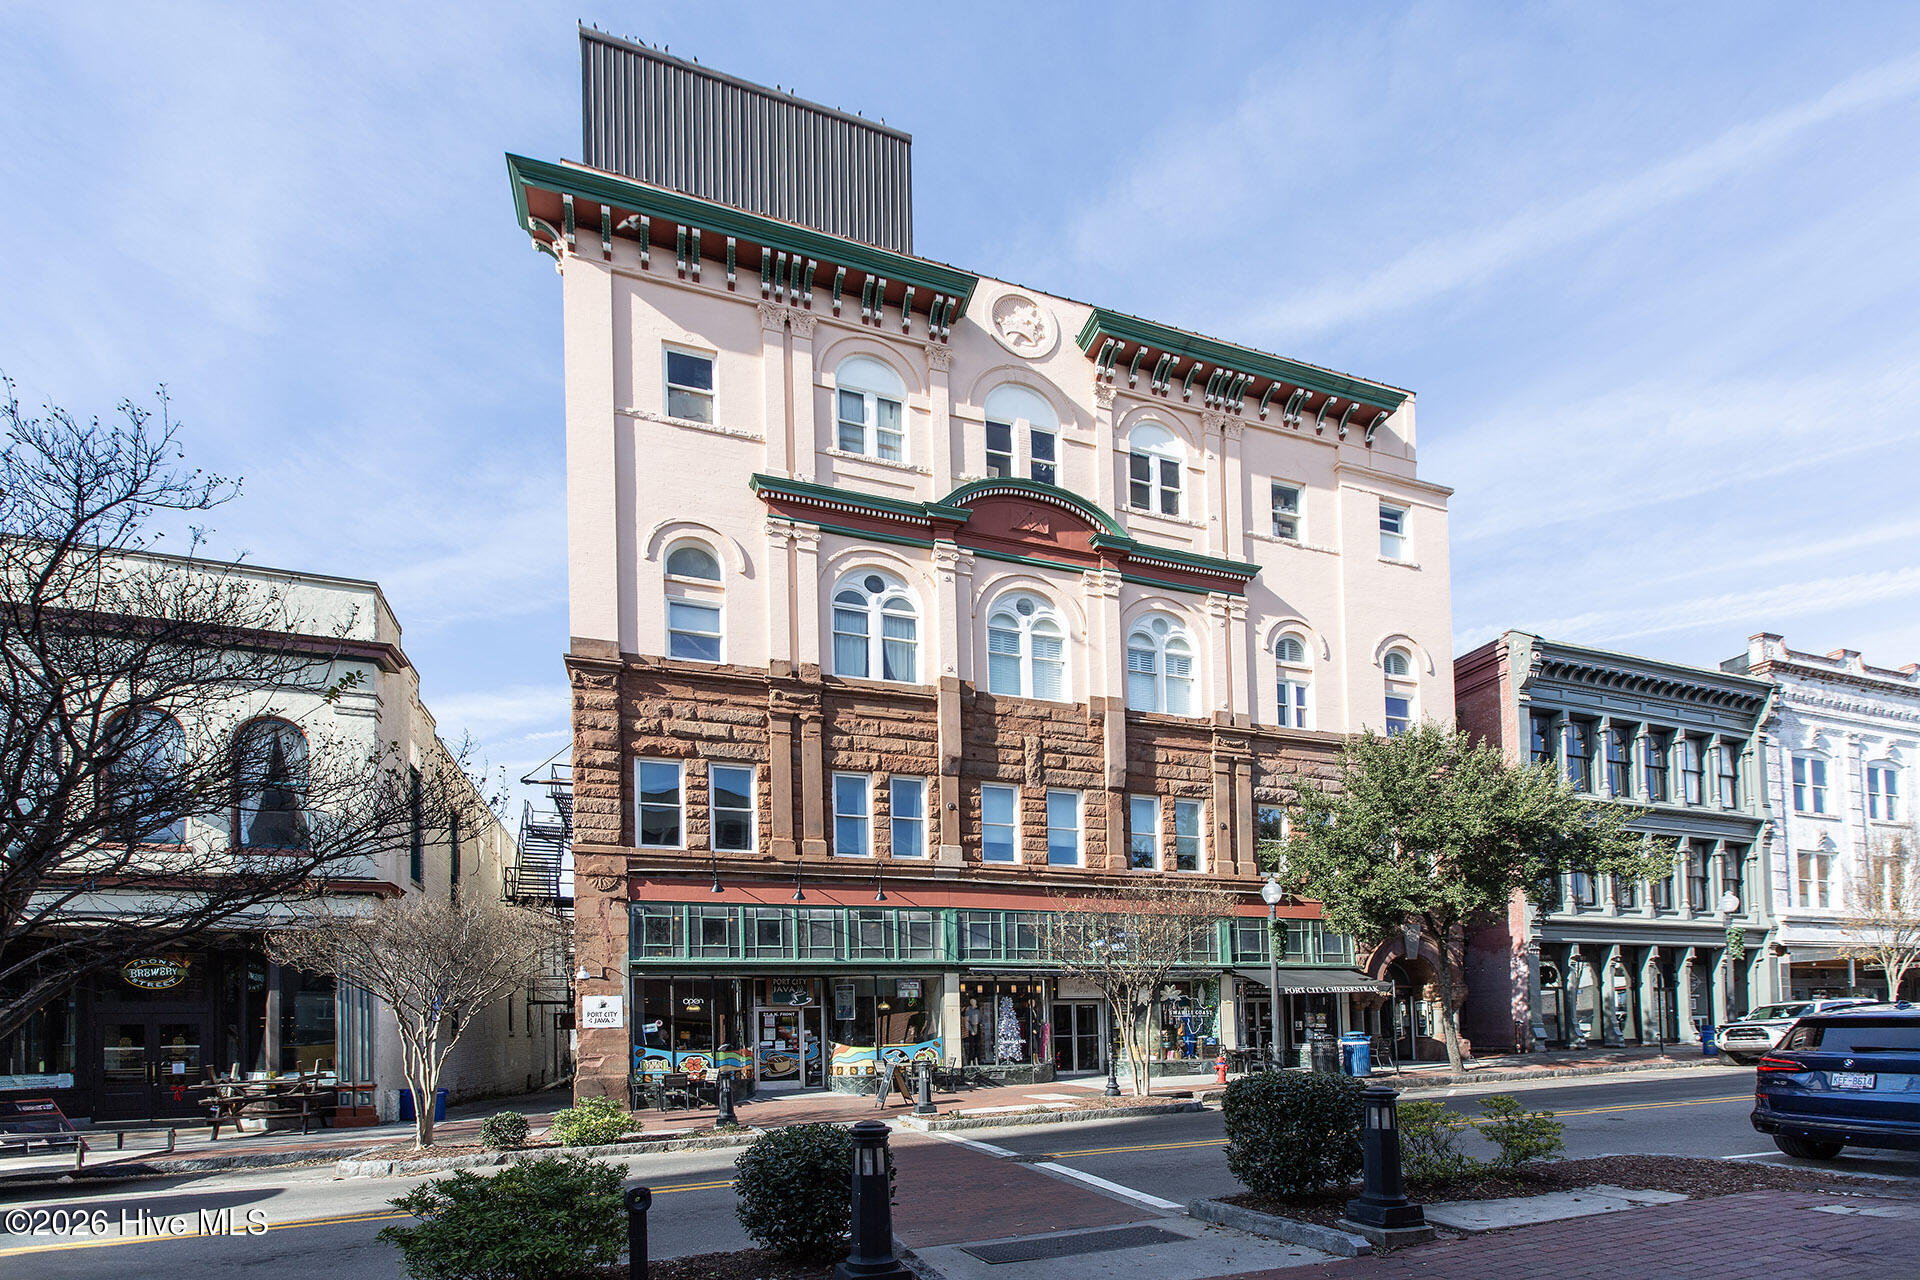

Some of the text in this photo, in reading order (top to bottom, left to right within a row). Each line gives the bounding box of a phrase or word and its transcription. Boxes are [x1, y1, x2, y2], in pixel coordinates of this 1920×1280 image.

[133, 958, 176, 967] FRONT
[128, 967, 178, 978] BREWERY
[131, 978, 176, 988] STREET
[773, 985, 796, 993] JAVA
[1284, 985, 1380, 994] PORT CITY CHEESESTEAK
[682, 998, 704, 1006] open
